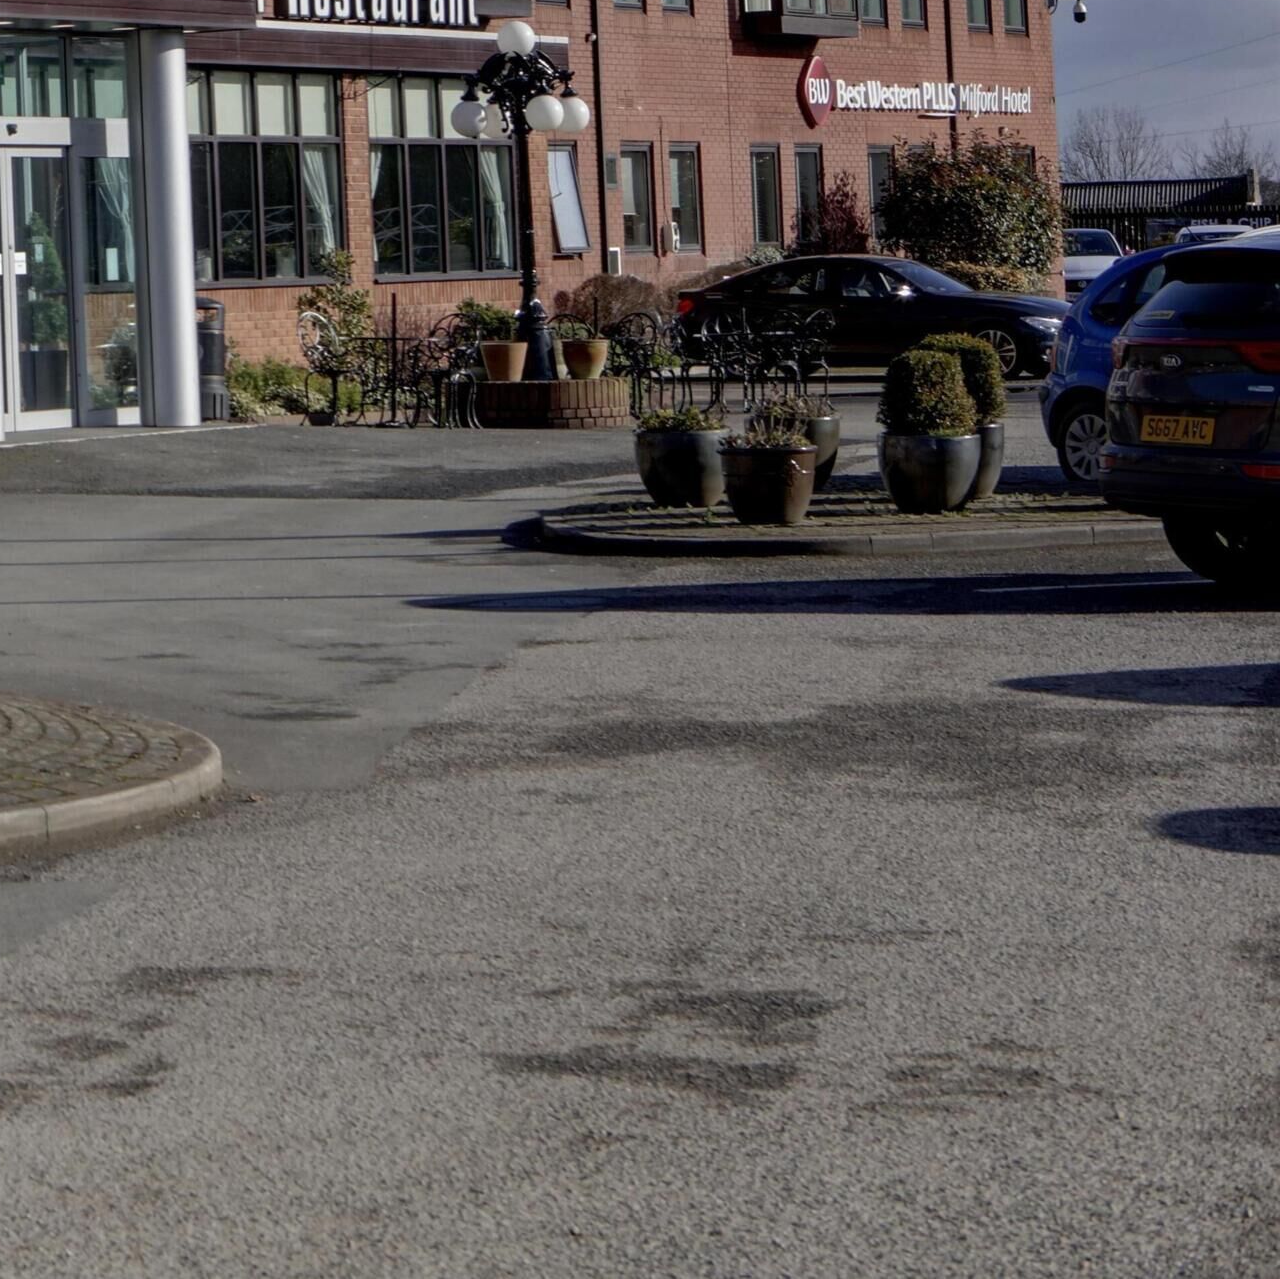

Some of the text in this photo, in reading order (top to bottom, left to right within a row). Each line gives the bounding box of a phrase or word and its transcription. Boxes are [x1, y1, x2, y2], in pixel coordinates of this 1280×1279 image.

[808, 77, 830, 105] BW
[836, 79, 1031, 118] Best Western PLUS Milford Hotel
[1147, 418, 1180, 437] SG67
